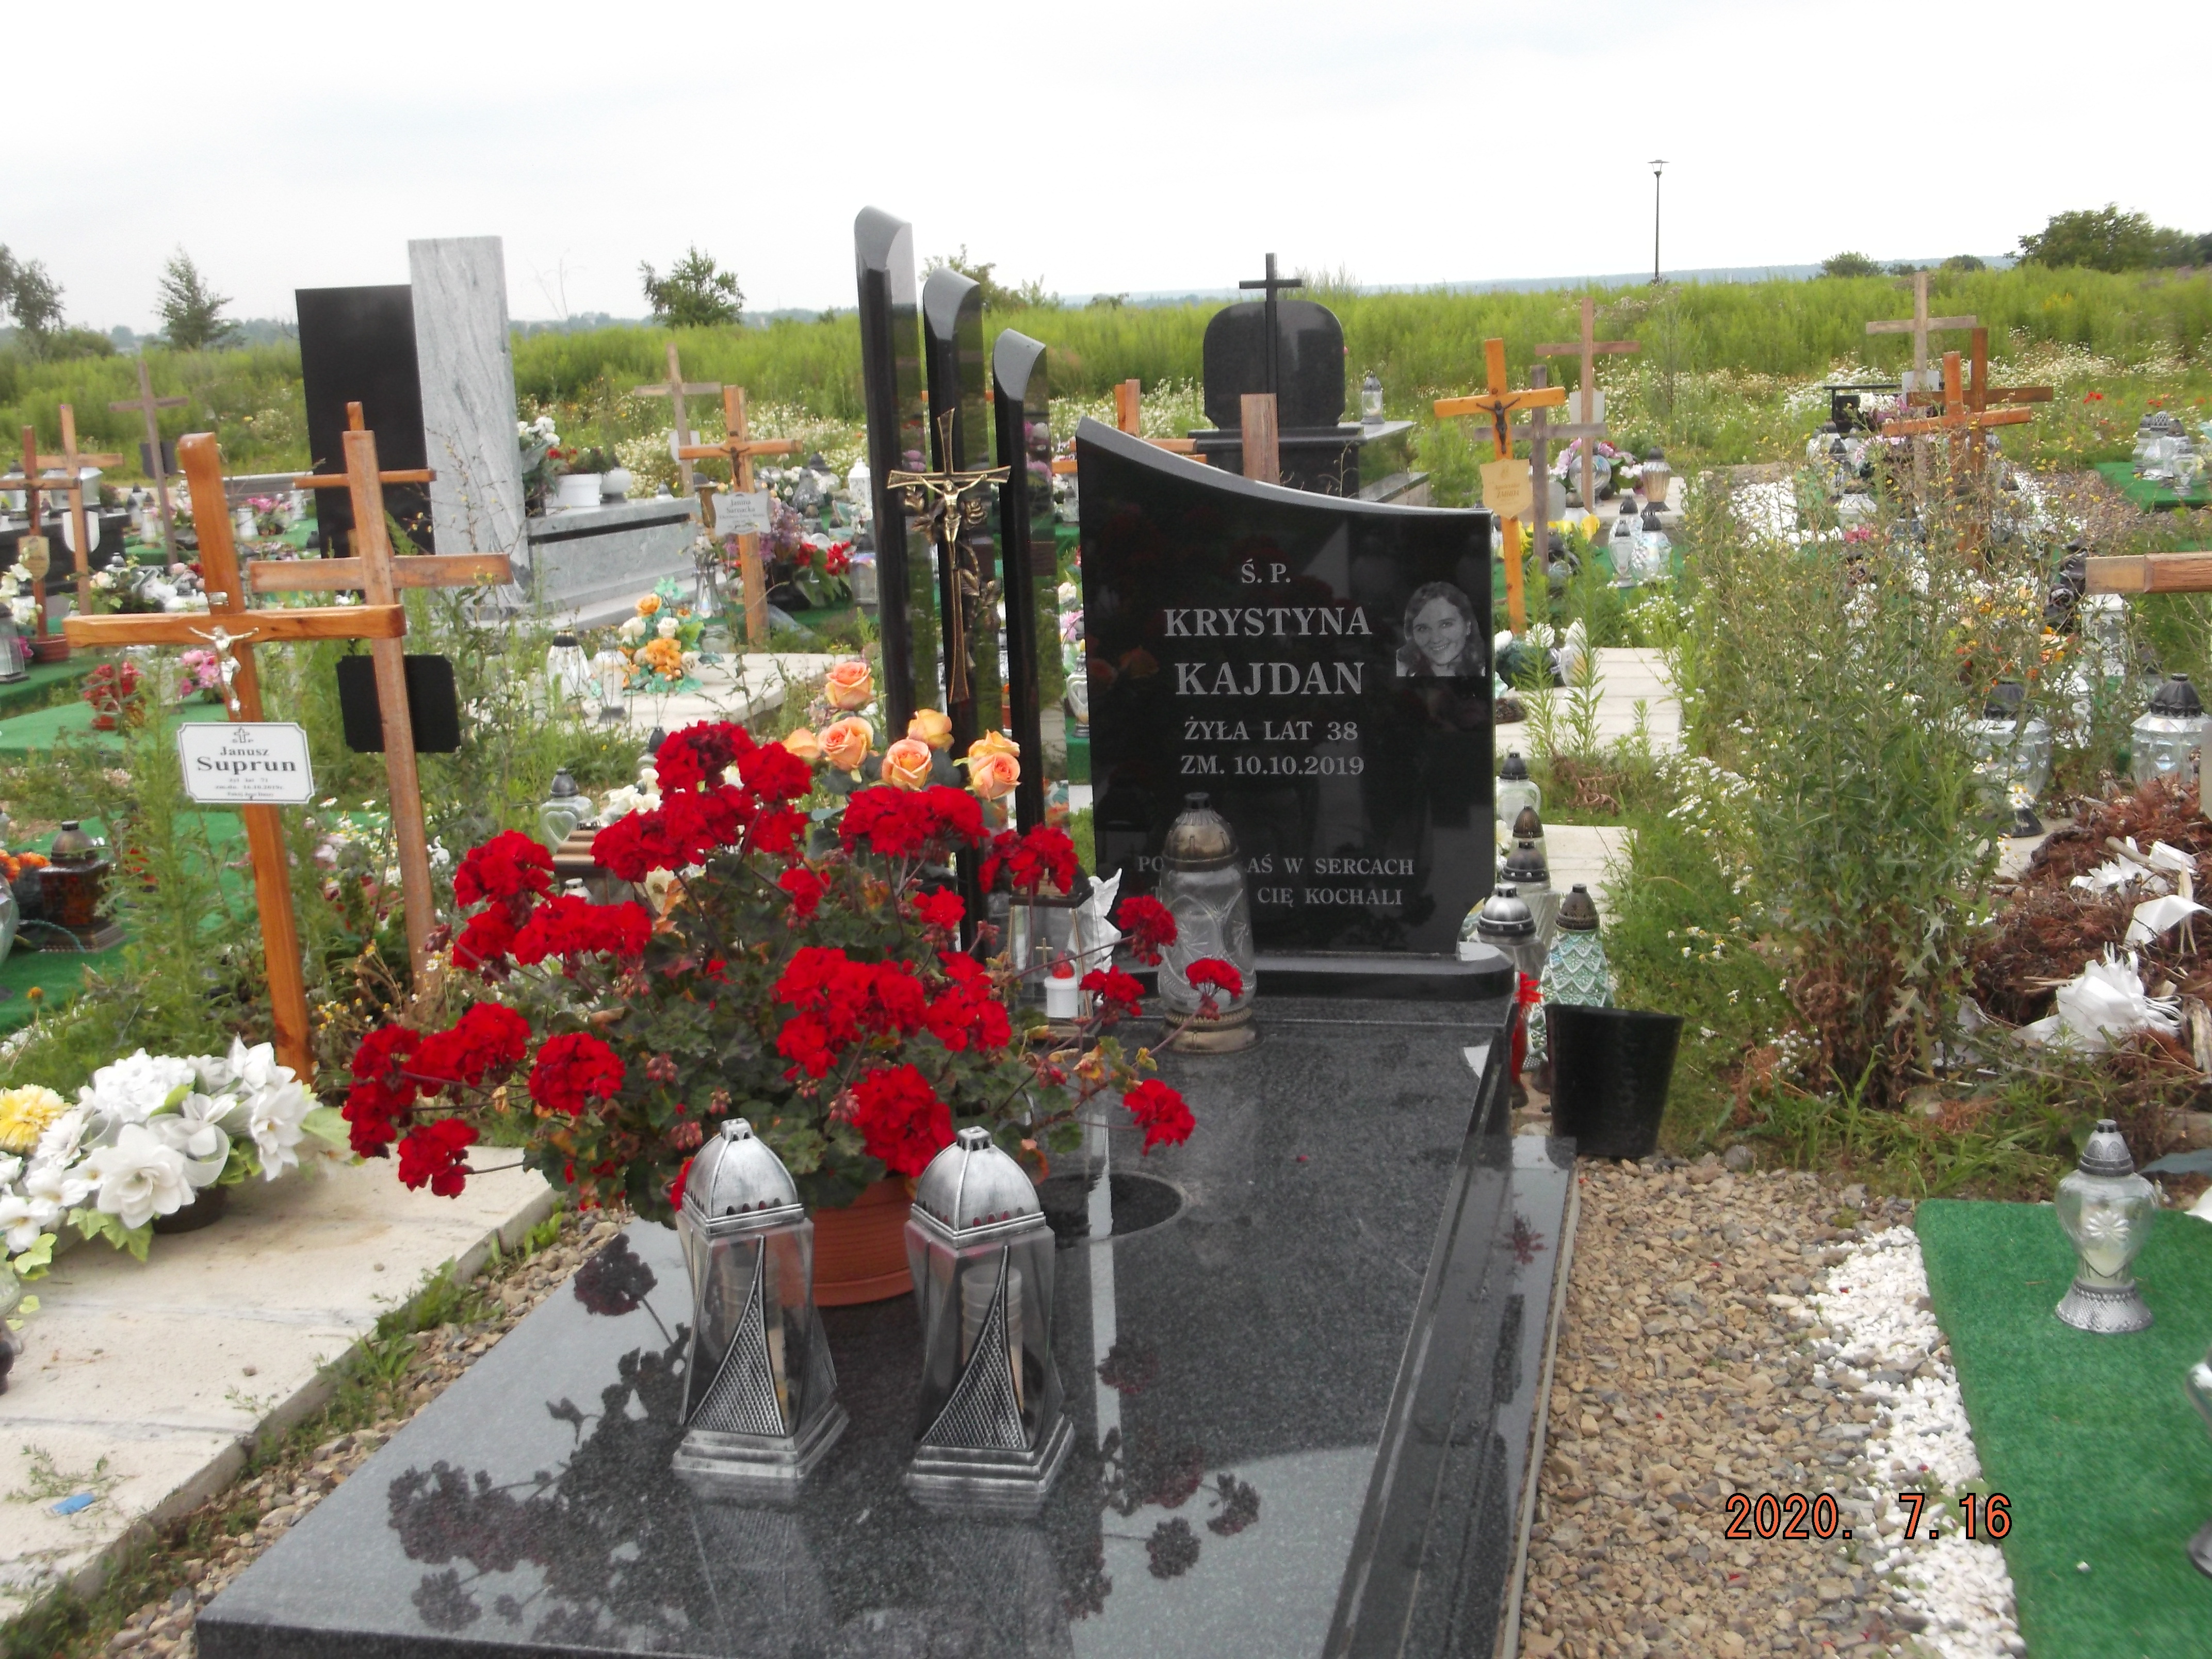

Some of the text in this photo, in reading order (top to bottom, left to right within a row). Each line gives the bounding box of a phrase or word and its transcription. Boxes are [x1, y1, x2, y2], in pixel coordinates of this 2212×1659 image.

[1241, 559, 1291, 583] Ś. P.
[1164, 606, 1372, 637] KRYSTYNA
[1174, 662, 1364, 695] KAJDAN
[1184, 716, 1358, 741] ŻYŁA LAT 38
[220, 746, 269, 756] Janusz
[197, 756, 296, 774] Suprun
[1181, 755, 1364, 775] ZM. 10.10.2019
[1284, 858, 1303, 873] W
[1315, 858, 1414, 875] SERCACH
[1257, 888, 1293, 907] CIĘ
[1306, 888, 1403, 905] KOCHALI
